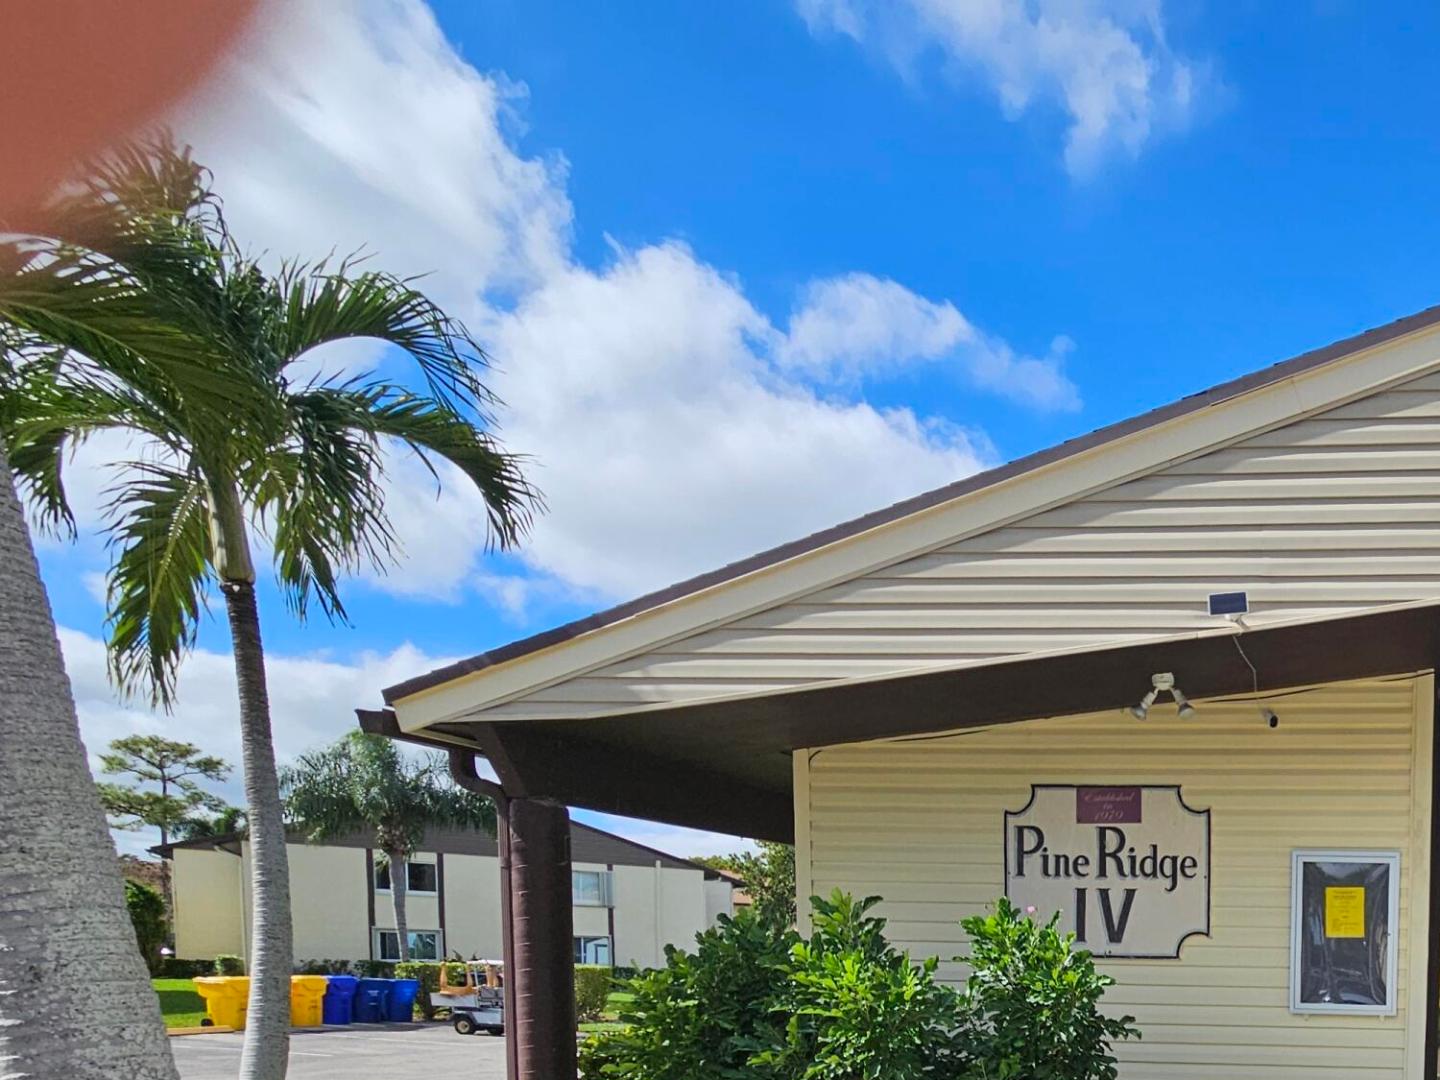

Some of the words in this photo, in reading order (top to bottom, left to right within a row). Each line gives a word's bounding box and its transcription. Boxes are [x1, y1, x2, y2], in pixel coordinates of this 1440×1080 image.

[1014, 825, 1090, 878] Pine
[1095, 826, 1198, 892] Ridge
[1075, 887, 1138, 944] IV
